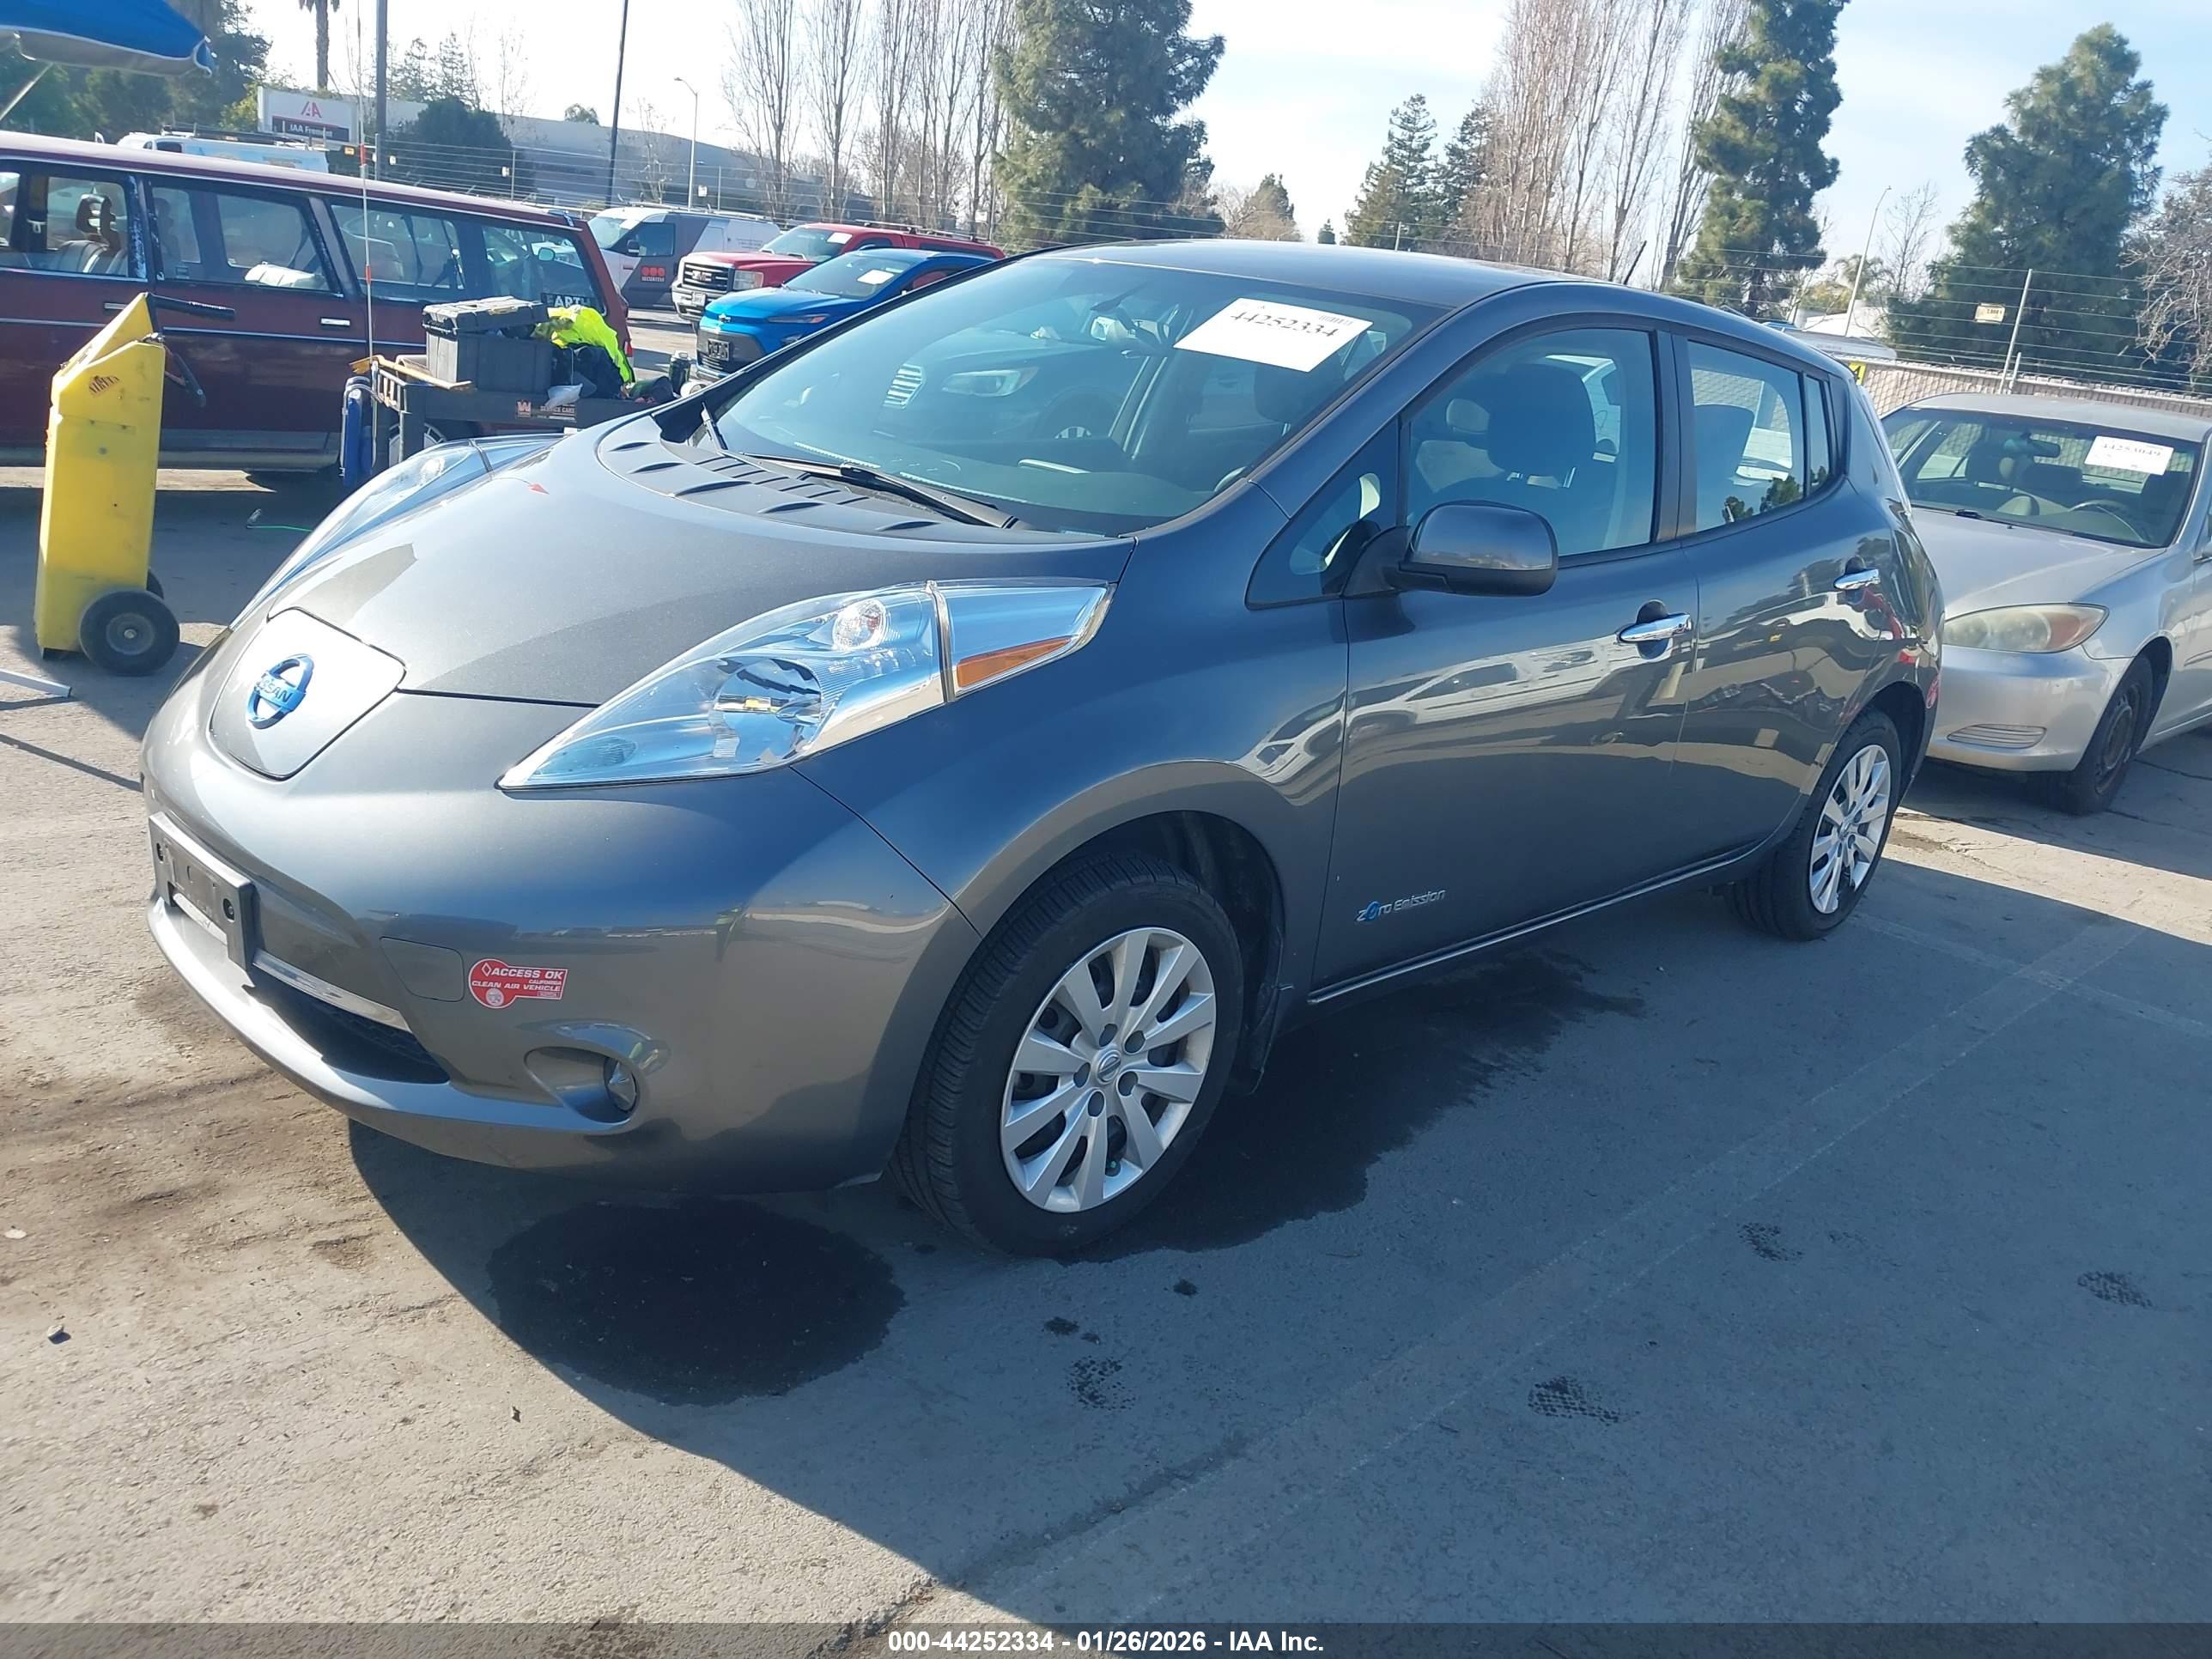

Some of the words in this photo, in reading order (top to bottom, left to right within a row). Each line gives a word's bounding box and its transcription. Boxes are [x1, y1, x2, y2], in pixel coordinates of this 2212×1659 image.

[1230, 311, 1340, 337] 44252334
[491, 968, 541, 979] ACCESS
[544, 970, 564, 980] OK
